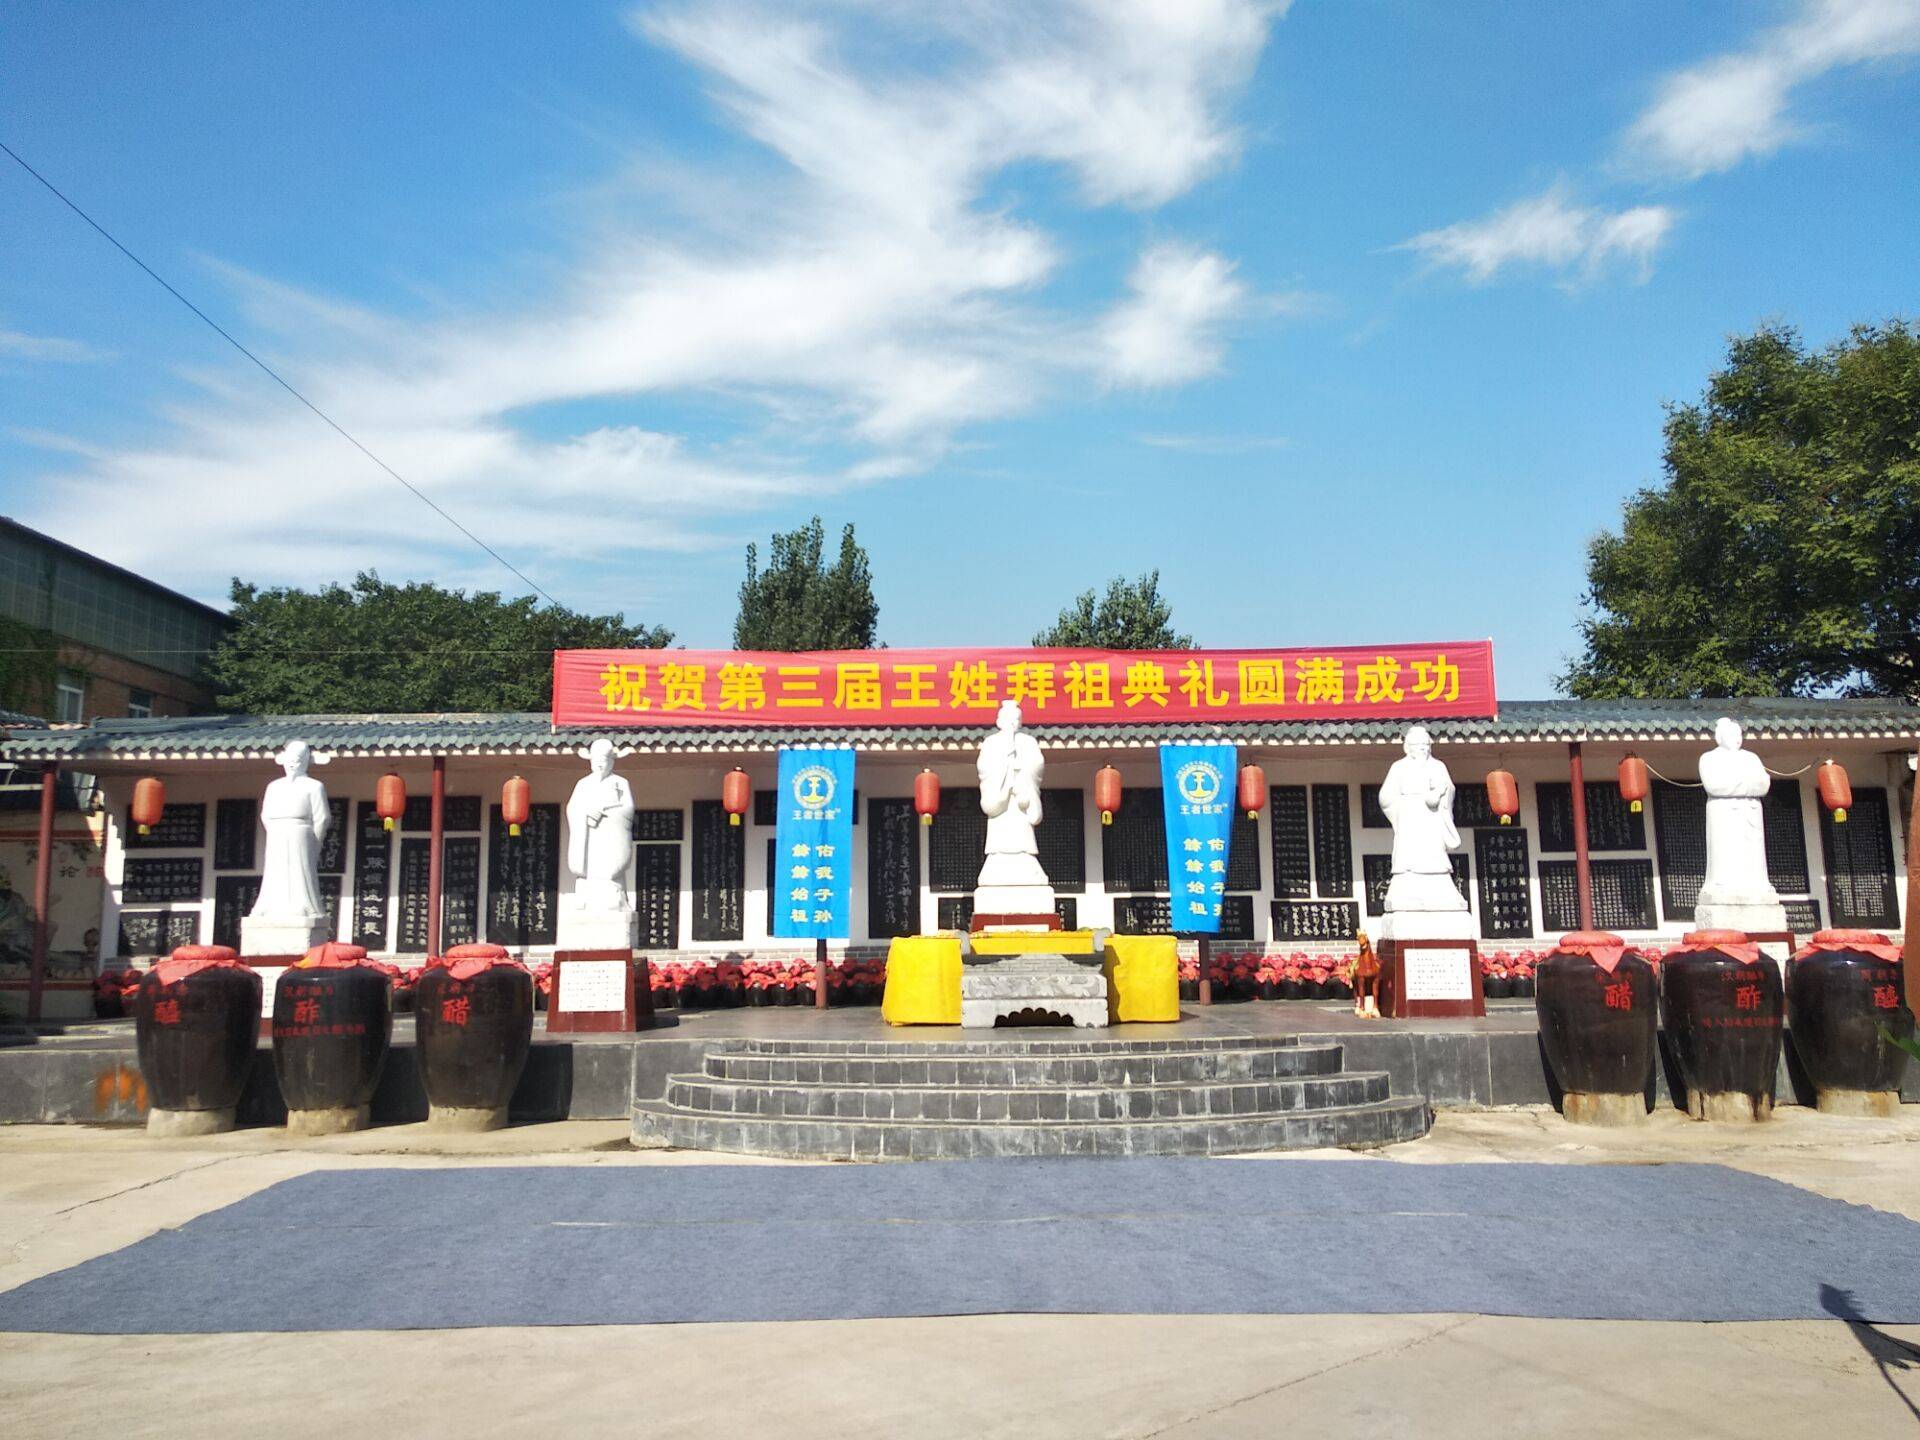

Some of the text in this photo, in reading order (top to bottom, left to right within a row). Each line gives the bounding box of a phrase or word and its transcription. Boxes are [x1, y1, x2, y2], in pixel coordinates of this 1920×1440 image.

[598, 654, 1461, 713] 祝贺第三届王姓拜祖典礼圆满成功
